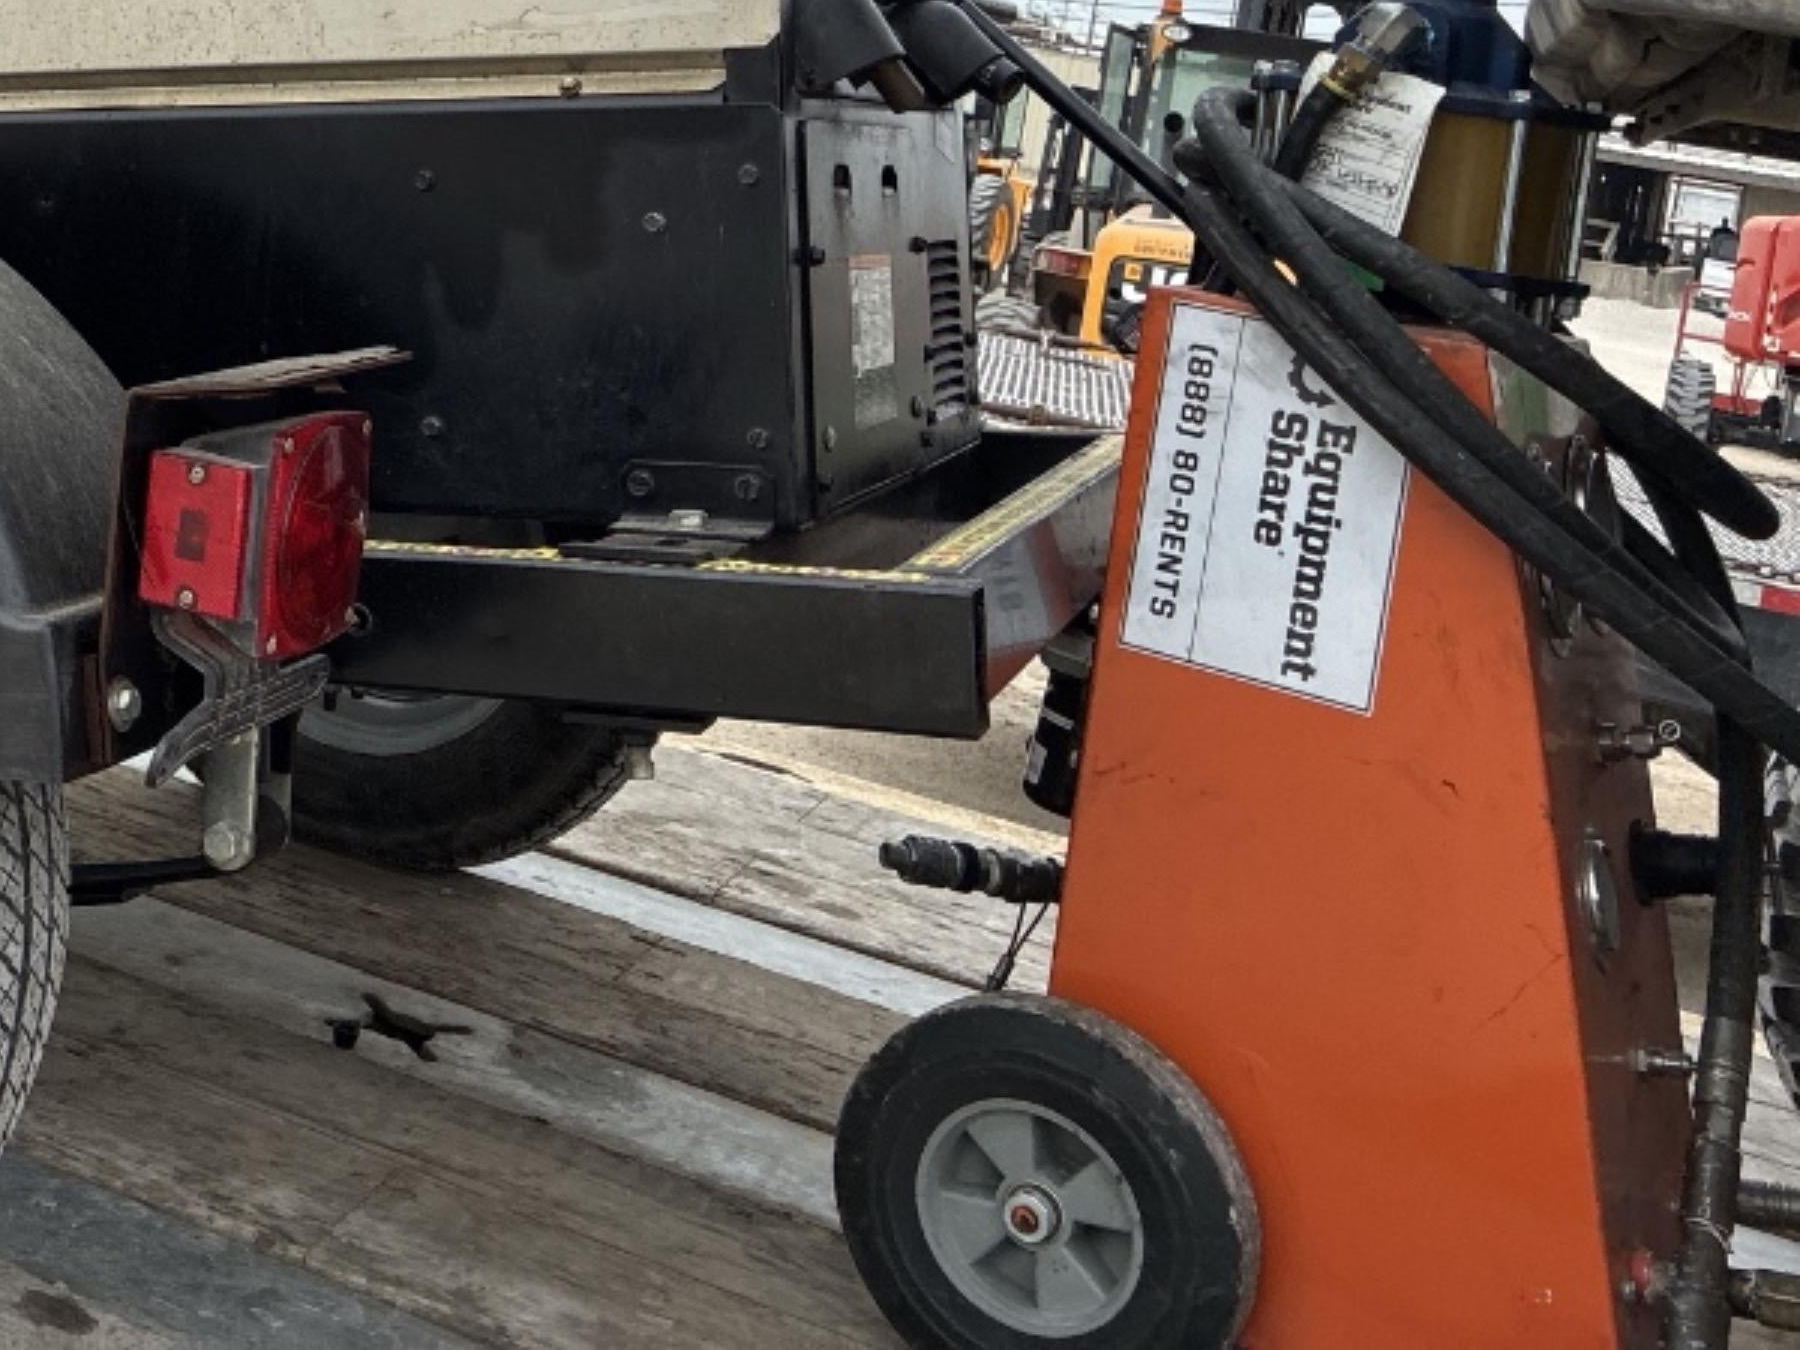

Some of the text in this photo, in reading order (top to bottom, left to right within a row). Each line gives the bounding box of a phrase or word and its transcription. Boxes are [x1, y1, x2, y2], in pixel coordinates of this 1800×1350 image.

[1149, 343, 1219, 620] (888) 80-RENTS
[1254, 408, 1309, 547] Share
[1281, 419, 1357, 682] Equipment
